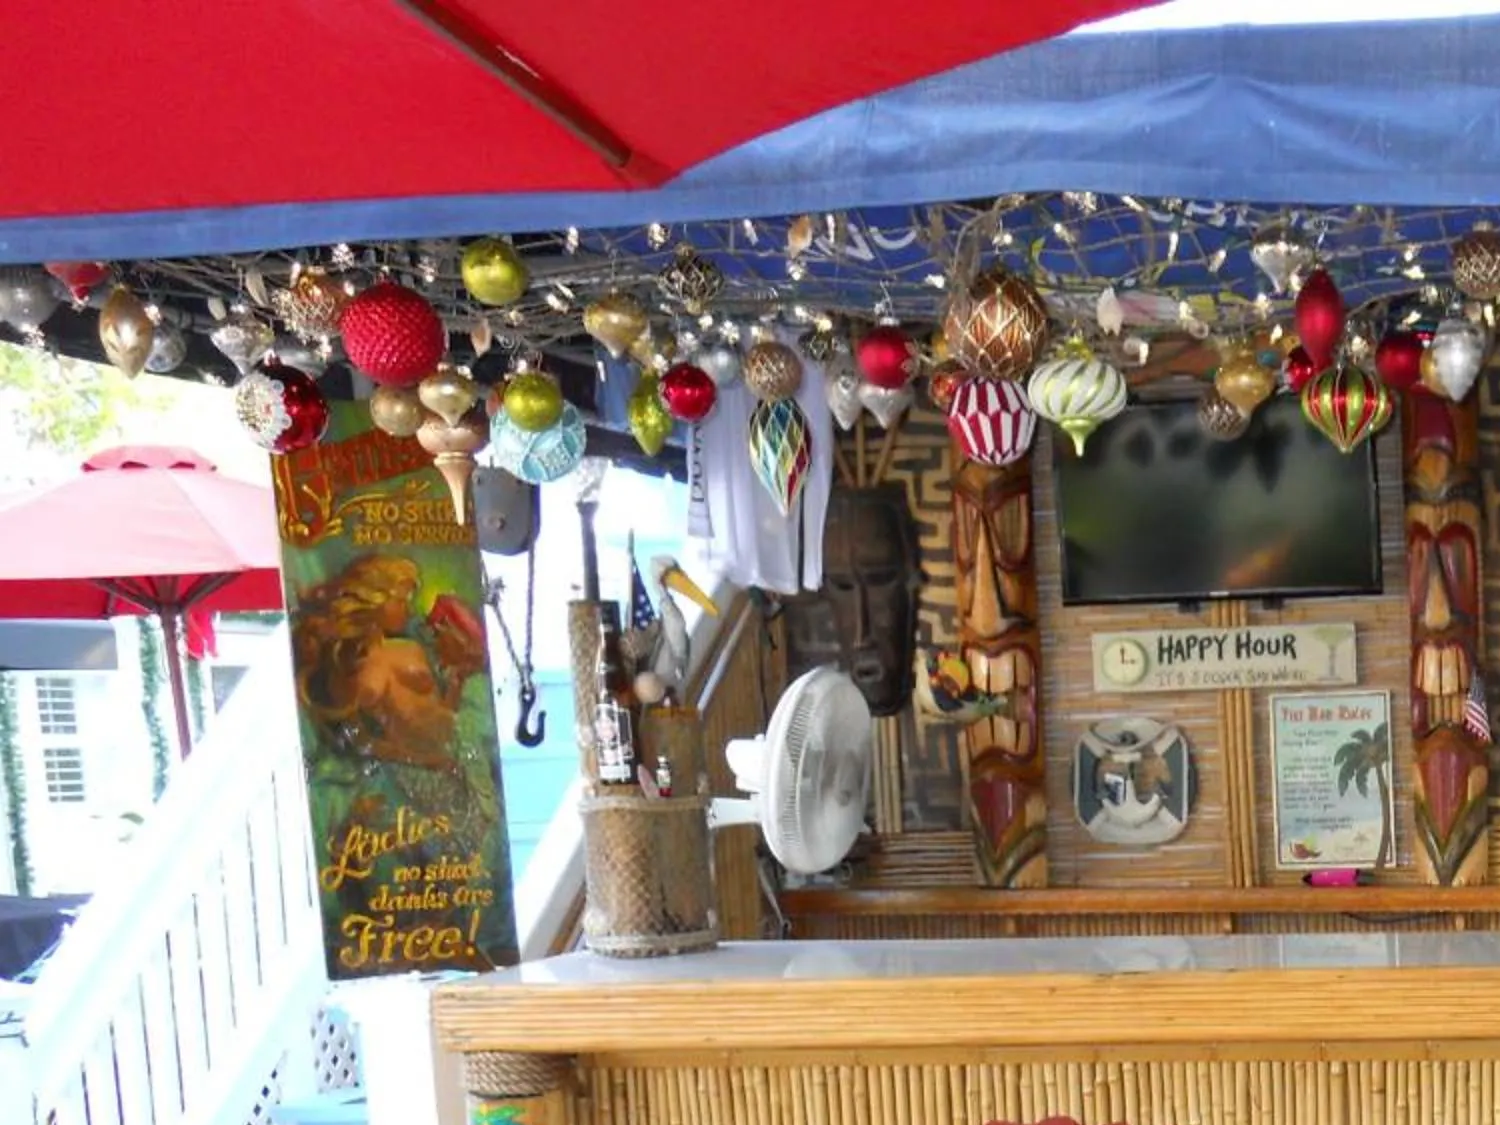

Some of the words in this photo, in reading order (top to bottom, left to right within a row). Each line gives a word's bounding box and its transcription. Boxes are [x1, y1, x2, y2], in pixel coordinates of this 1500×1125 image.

[364, 501, 399, 524] NO
[403, 501, 467, 524] SHIR
[353, 523, 392, 545] NO
[1157, 633, 1228, 665] HAPPY
[1235, 630, 1297, 660] HOUR
[320, 805, 451, 891] Ladies
[393, 865, 421, 883] no
[368, 883, 449, 911] drinks
[453, 884, 493, 906] are
[340, 909, 480, 968] Free!
